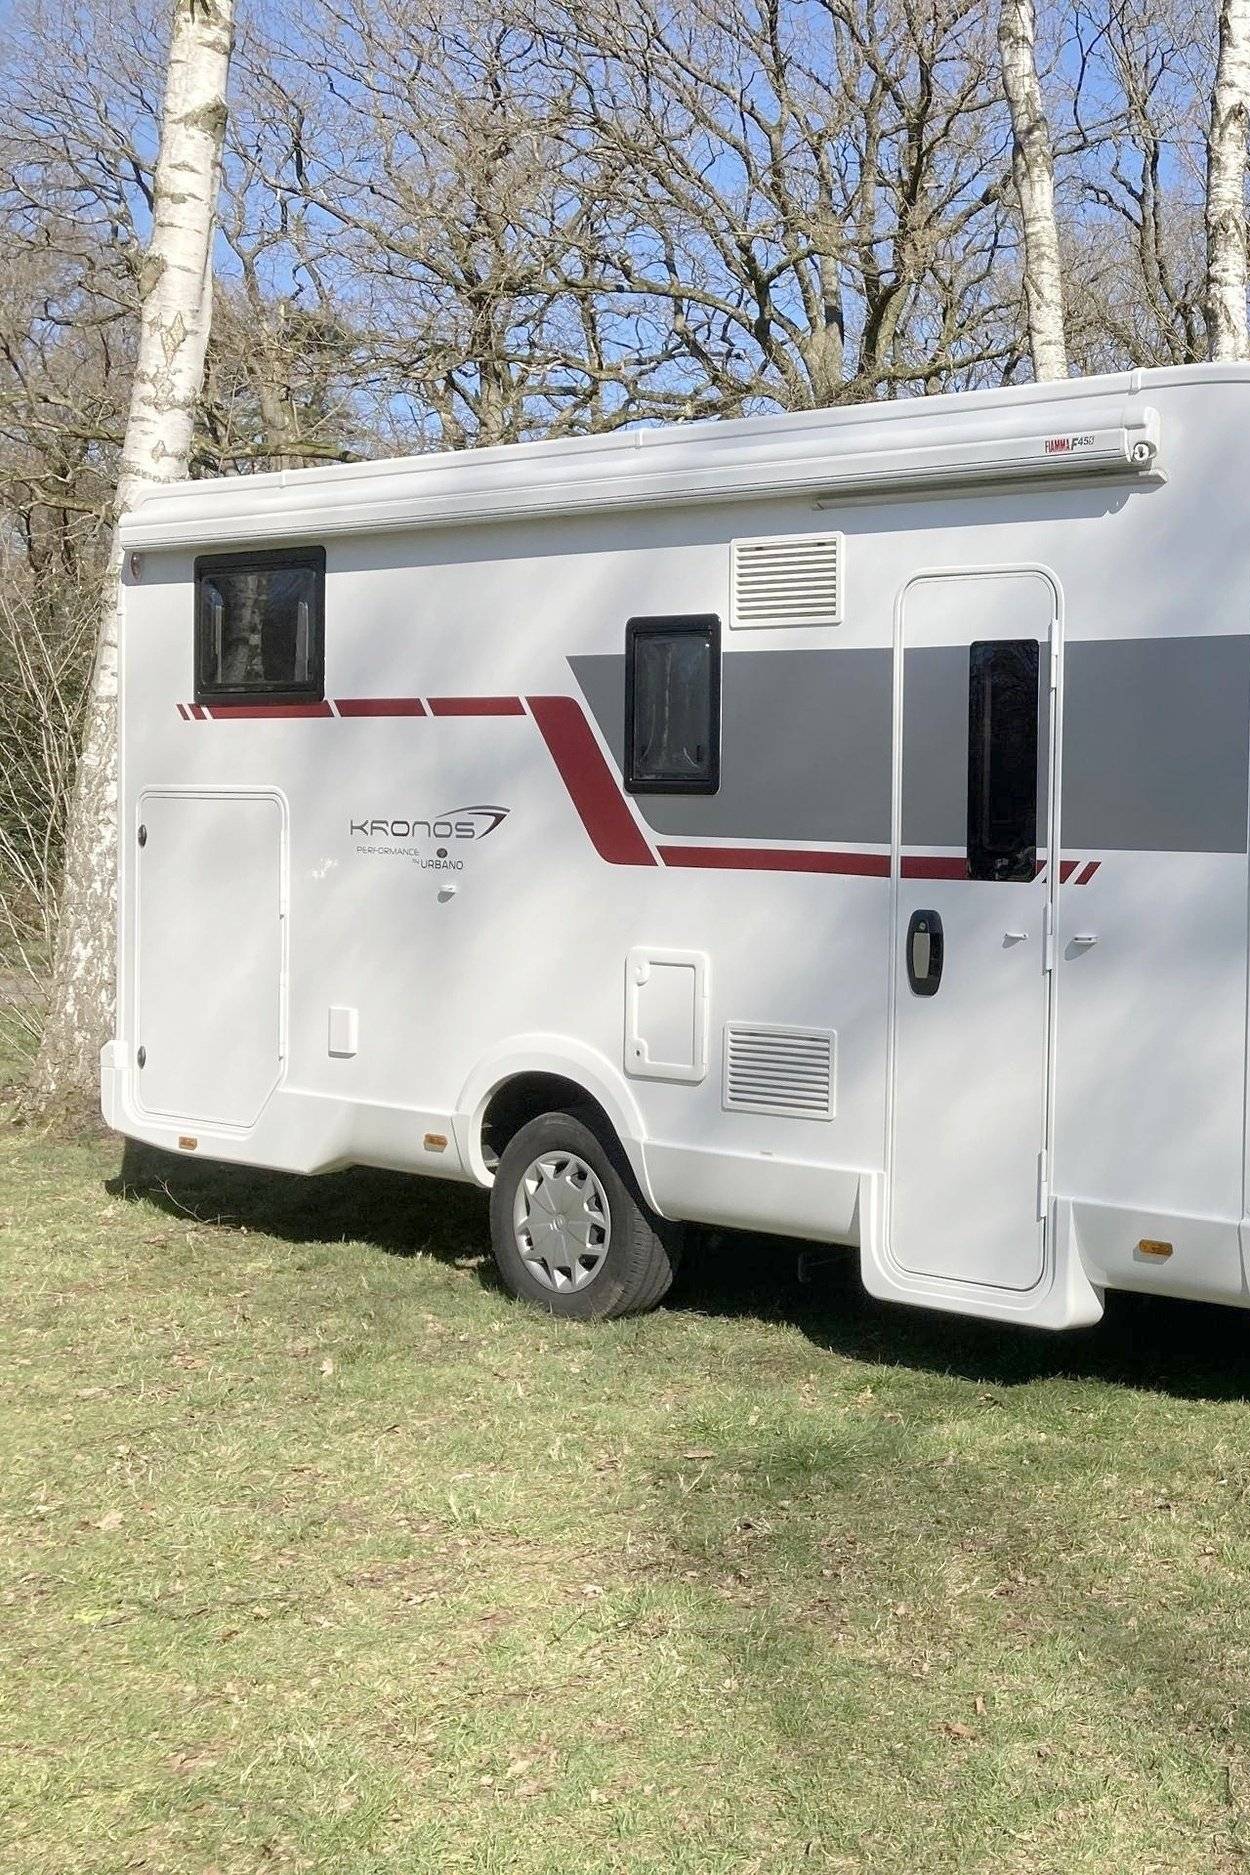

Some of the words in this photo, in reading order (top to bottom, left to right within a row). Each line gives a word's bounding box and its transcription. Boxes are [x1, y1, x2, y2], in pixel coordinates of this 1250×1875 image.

[1045, 438, 1071, 453] FIAMMA
[350, 819, 476, 839] KRONOS
[356, 846, 420, 857] PERFORMANCE
[420, 859, 464, 870] URBANO
